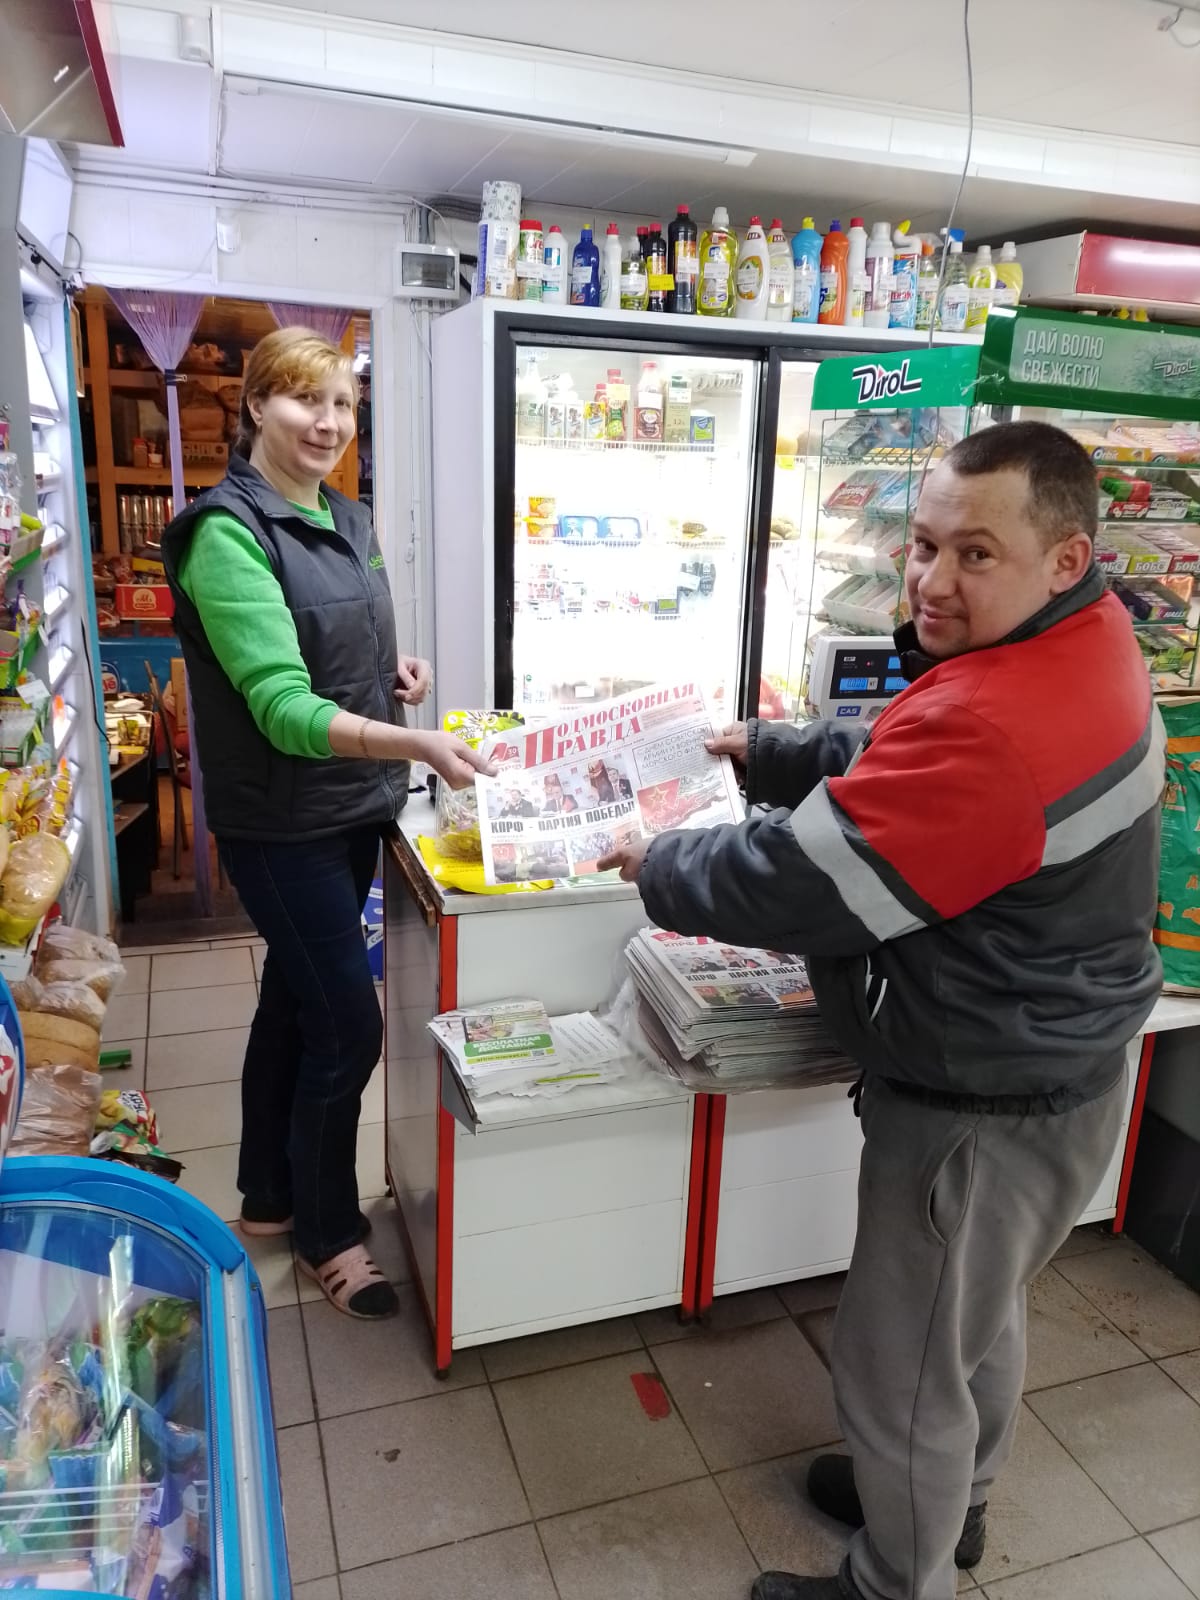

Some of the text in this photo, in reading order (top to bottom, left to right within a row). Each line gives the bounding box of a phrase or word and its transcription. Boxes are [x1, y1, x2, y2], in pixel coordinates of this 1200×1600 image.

[1024, 328, 1104, 360] ДАЙ ВОЛЮ
[1022, 359, 1100, 388] СВЕЖЕСТИ
[840, 707, 858, 715] CAS
[491, 821, 523, 834] КПРФ
[538, 814, 581, 831] ПАРТИЯ
[586, 800, 636, 821] ПОБЕДЫ!
[728, 968, 769, 979] ПАРТИЯ
[473, 1035, 541, 1049] БЕСПЛАТНАЯ
[478, 1041, 536, 1053] ДОСТАВКА
